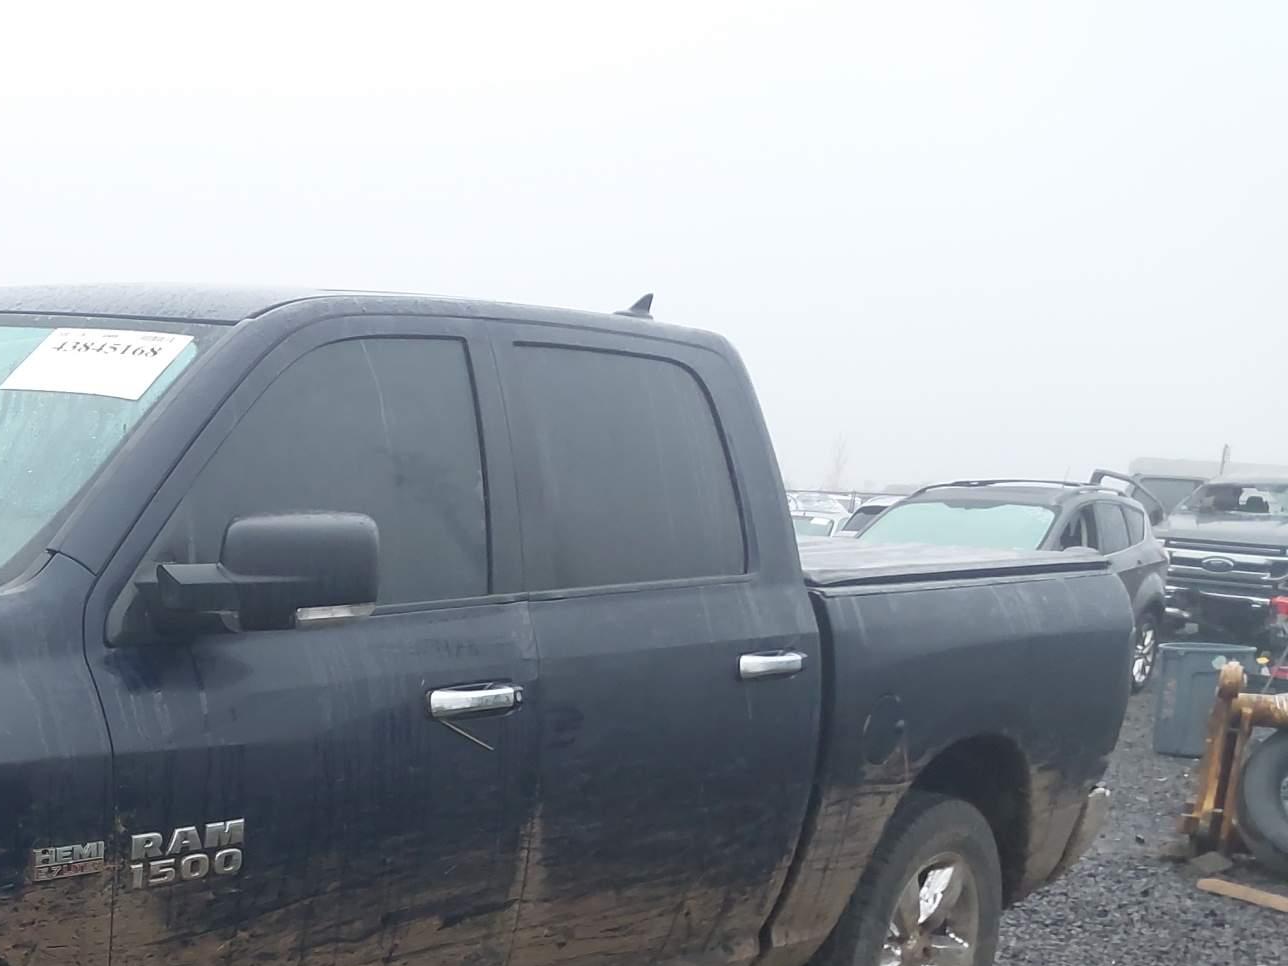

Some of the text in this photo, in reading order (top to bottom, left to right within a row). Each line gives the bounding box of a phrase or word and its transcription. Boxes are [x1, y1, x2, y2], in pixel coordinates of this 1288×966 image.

[53, 341, 162, 357] 43845168
[33, 841, 105, 867] HEMI
[131, 818, 245, 861] RAM
[130, 848, 243, 890] 1500
